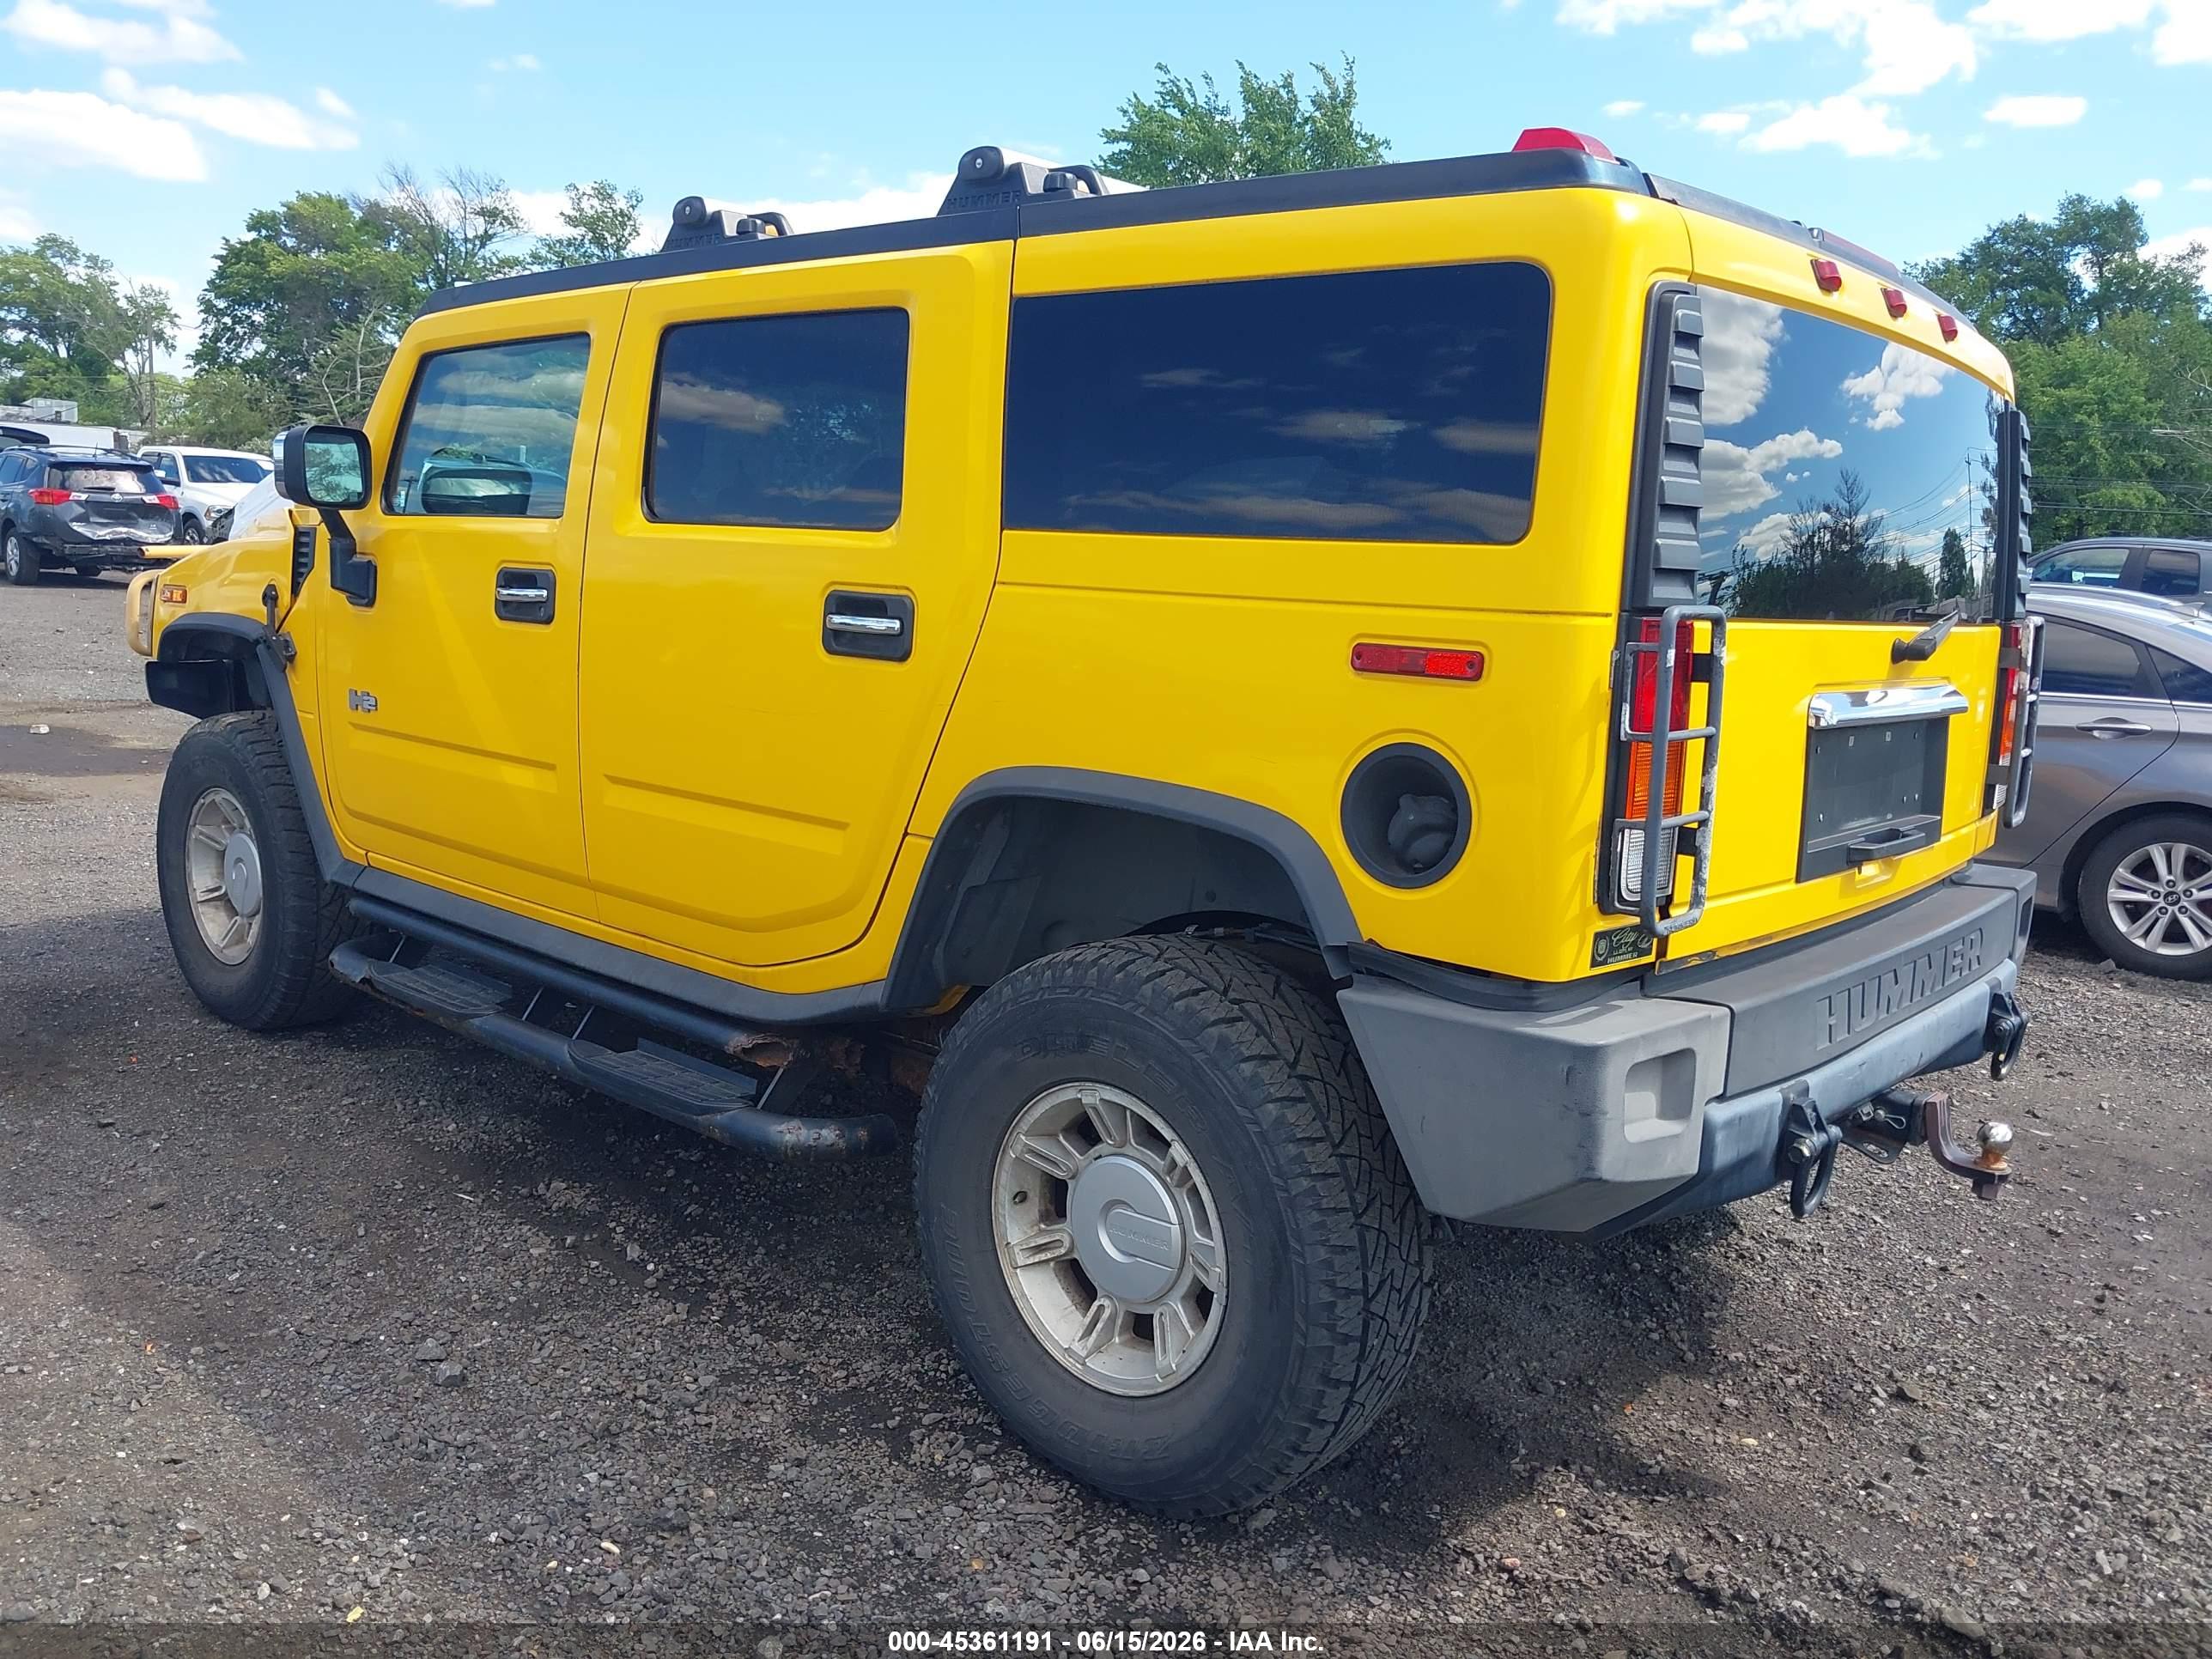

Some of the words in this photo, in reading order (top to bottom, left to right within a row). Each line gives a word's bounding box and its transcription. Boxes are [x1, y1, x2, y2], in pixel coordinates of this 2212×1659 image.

[945, 189, 1021, 209] HUMMER
[348, 688, 378, 713] H2
[1607, 951, 1638, 963] HUMMER
[1814, 927, 1984, 1051] HUMMER
